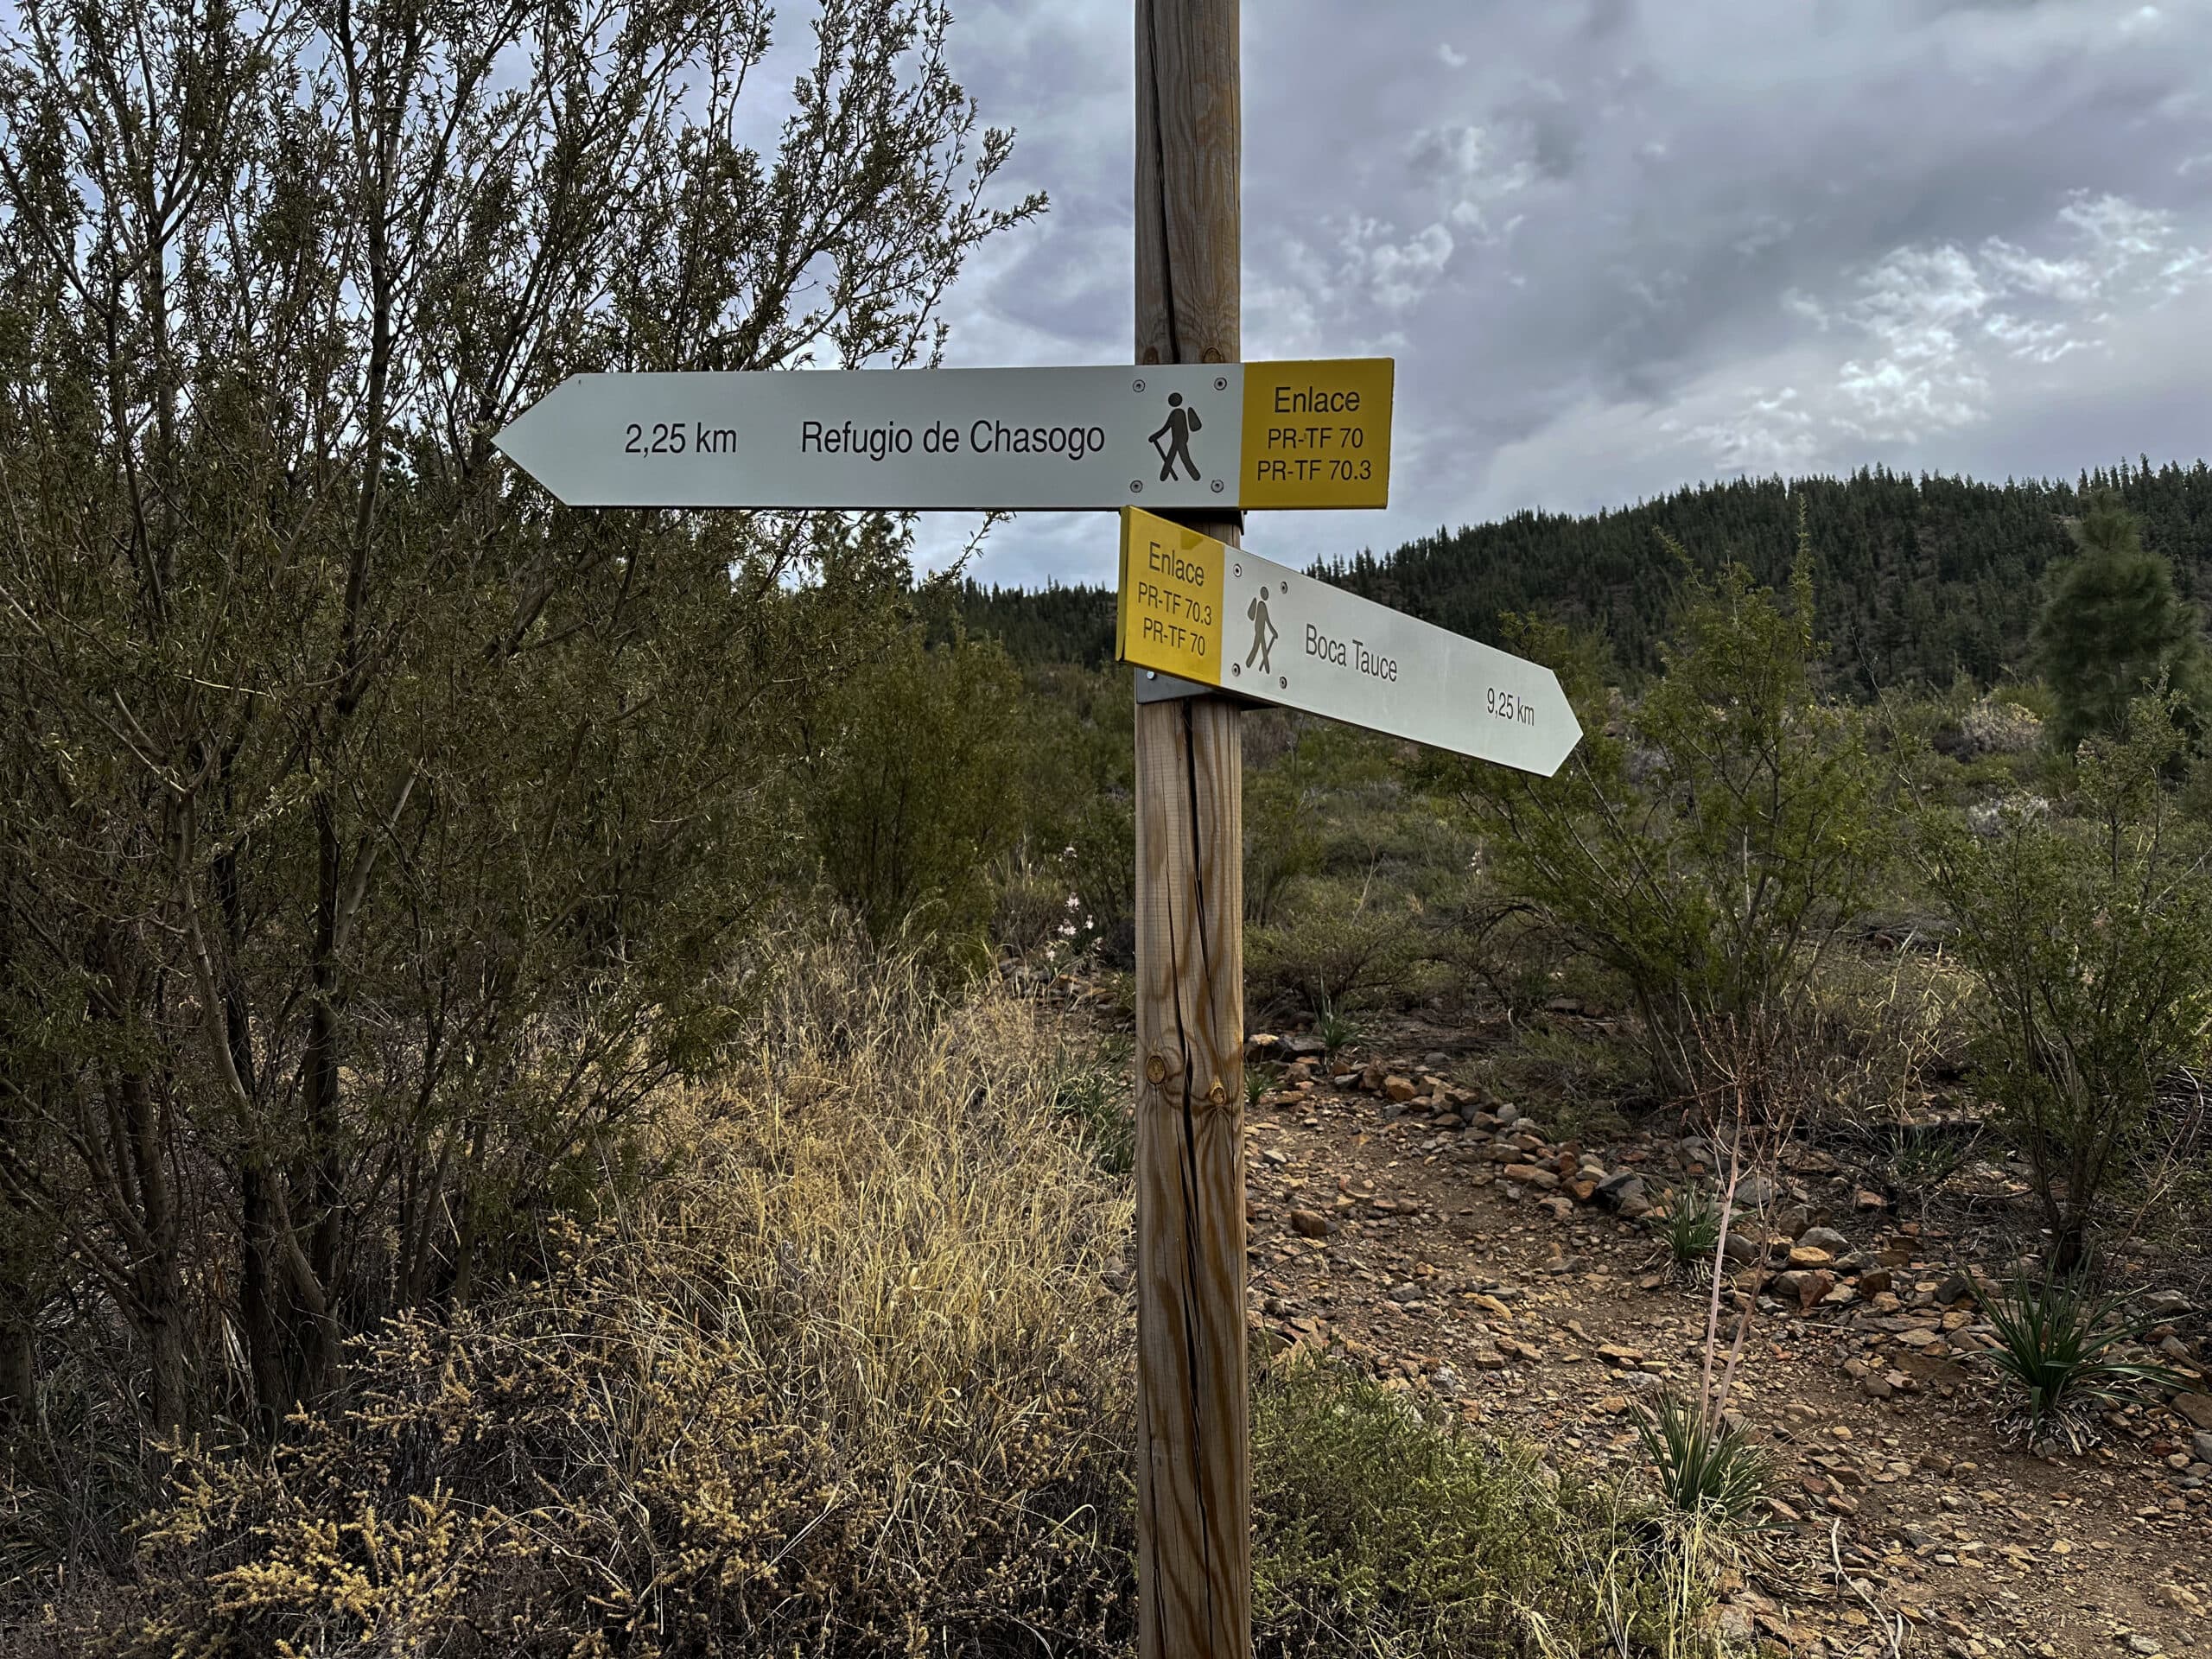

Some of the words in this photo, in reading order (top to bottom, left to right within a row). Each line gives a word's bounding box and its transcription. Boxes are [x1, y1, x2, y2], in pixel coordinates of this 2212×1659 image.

[1274, 386, 1360, 413] Enlace
[626, 423, 687, 456] 2,25
[696, 422, 738, 454] km
[801, 420, 913, 461] Refugio
[923, 420, 960, 454] de
[969, 419, 1106, 461] Chasogo
[1268, 428, 1333, 448] PR-TF
[1339, 428, 1363, 448] 70
[1257, 460, 1322, 480] PR-TF
[1329, 460, 1371, 480] 70.3
[1148, 541, 1205, 587] Enlace
[1138, 582, 1181, 614] PR-TF
[1185, 599, 1212, 626] 70.3
[1143, 617, 1185, 649] PR-TF
[1190, 633, 1205, 657] 70
[1306, 623, 1347, 667] Boca
[1351, 639, 1397, 682] Tauce
[1486, 688, 1514, 720] 9,25
[1517, 696, 1535, 726] km
